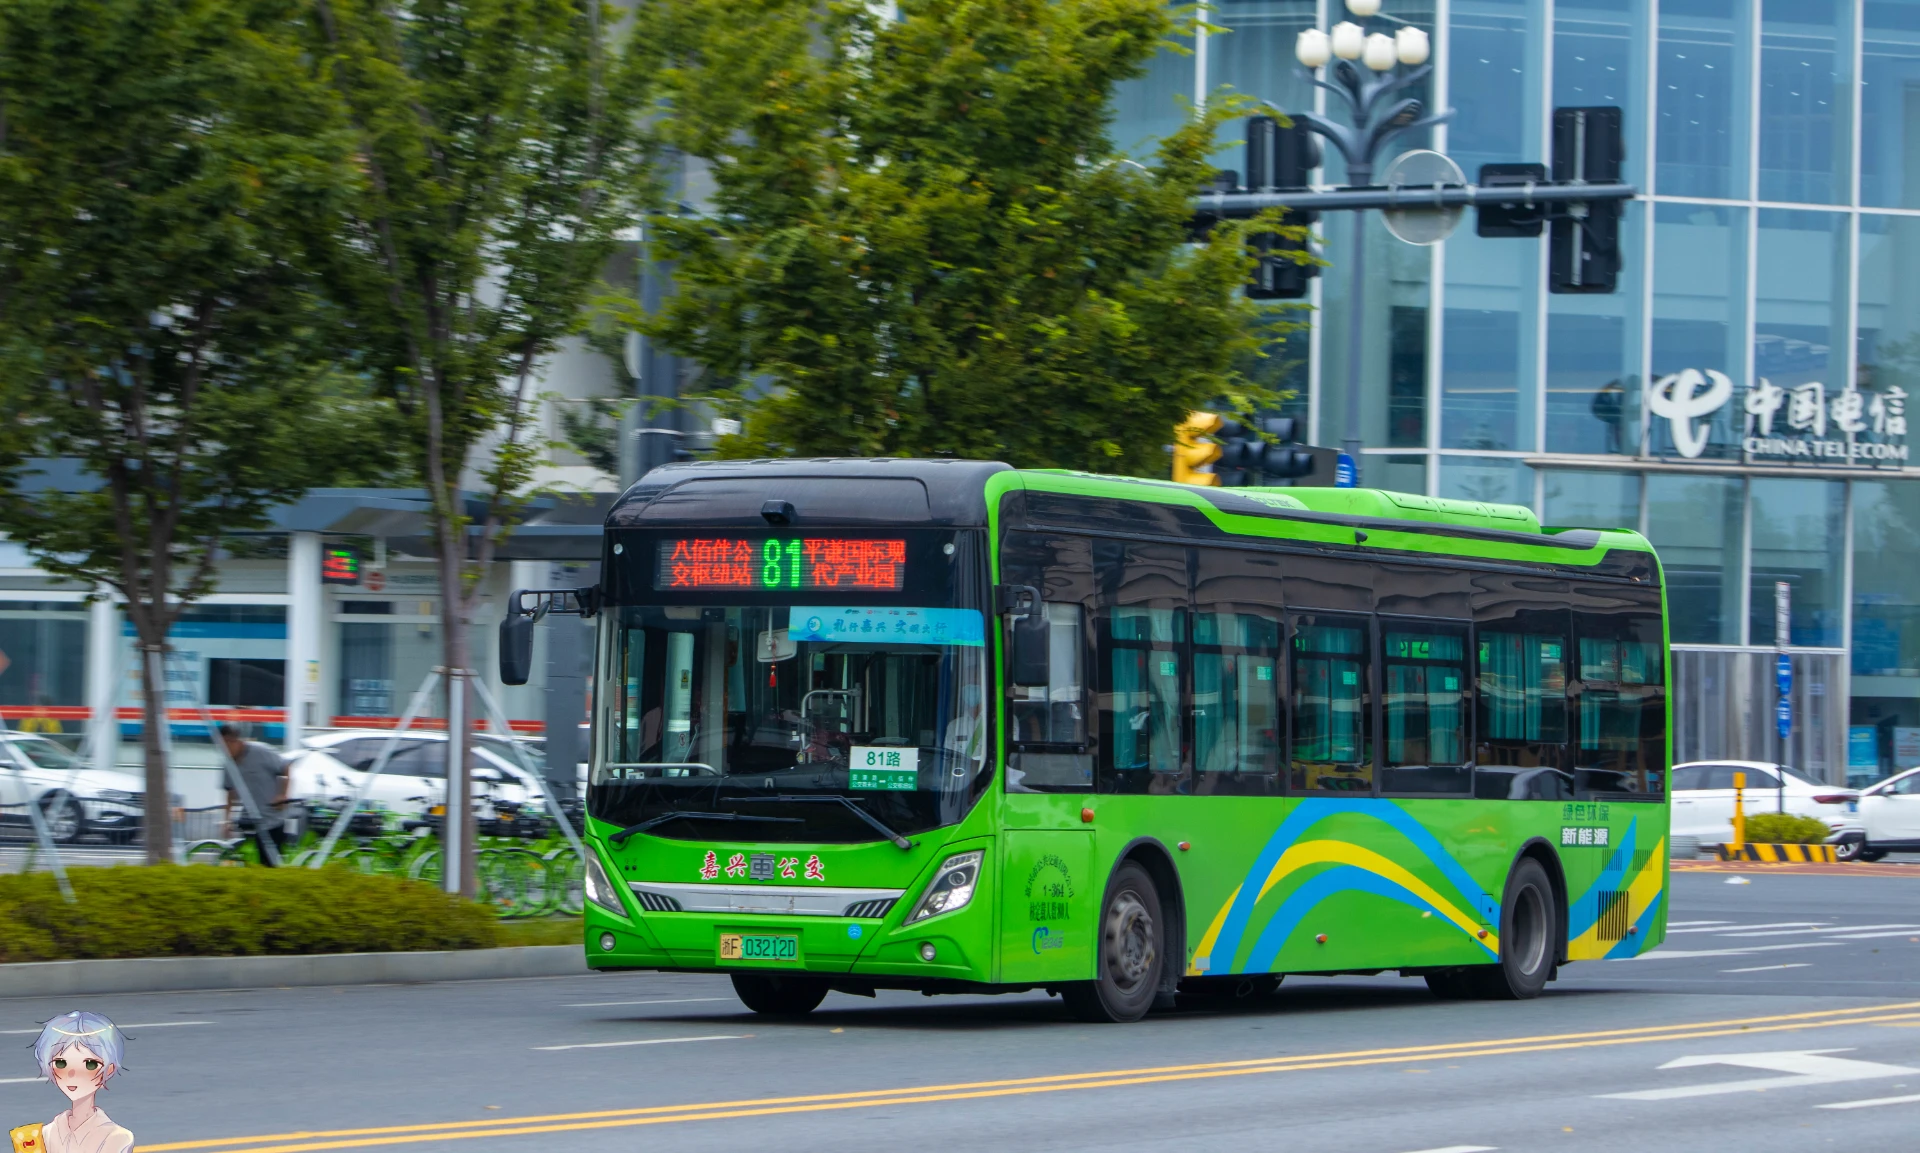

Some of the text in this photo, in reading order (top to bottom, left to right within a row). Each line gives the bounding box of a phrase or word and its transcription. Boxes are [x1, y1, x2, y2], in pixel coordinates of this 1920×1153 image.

[1744, 377, 1909, 436] 中国电信
[1743, 437, 1909, 460] CHINA TELECOM
[763, 539, 800, 587] 81
[812, 563, 896, 588] 代产业园
[866, 751, 901, 767] 81路
[1562, 804, 1609, 821] 绿色环保
[1561, 827, 1609, 845] 新能源
